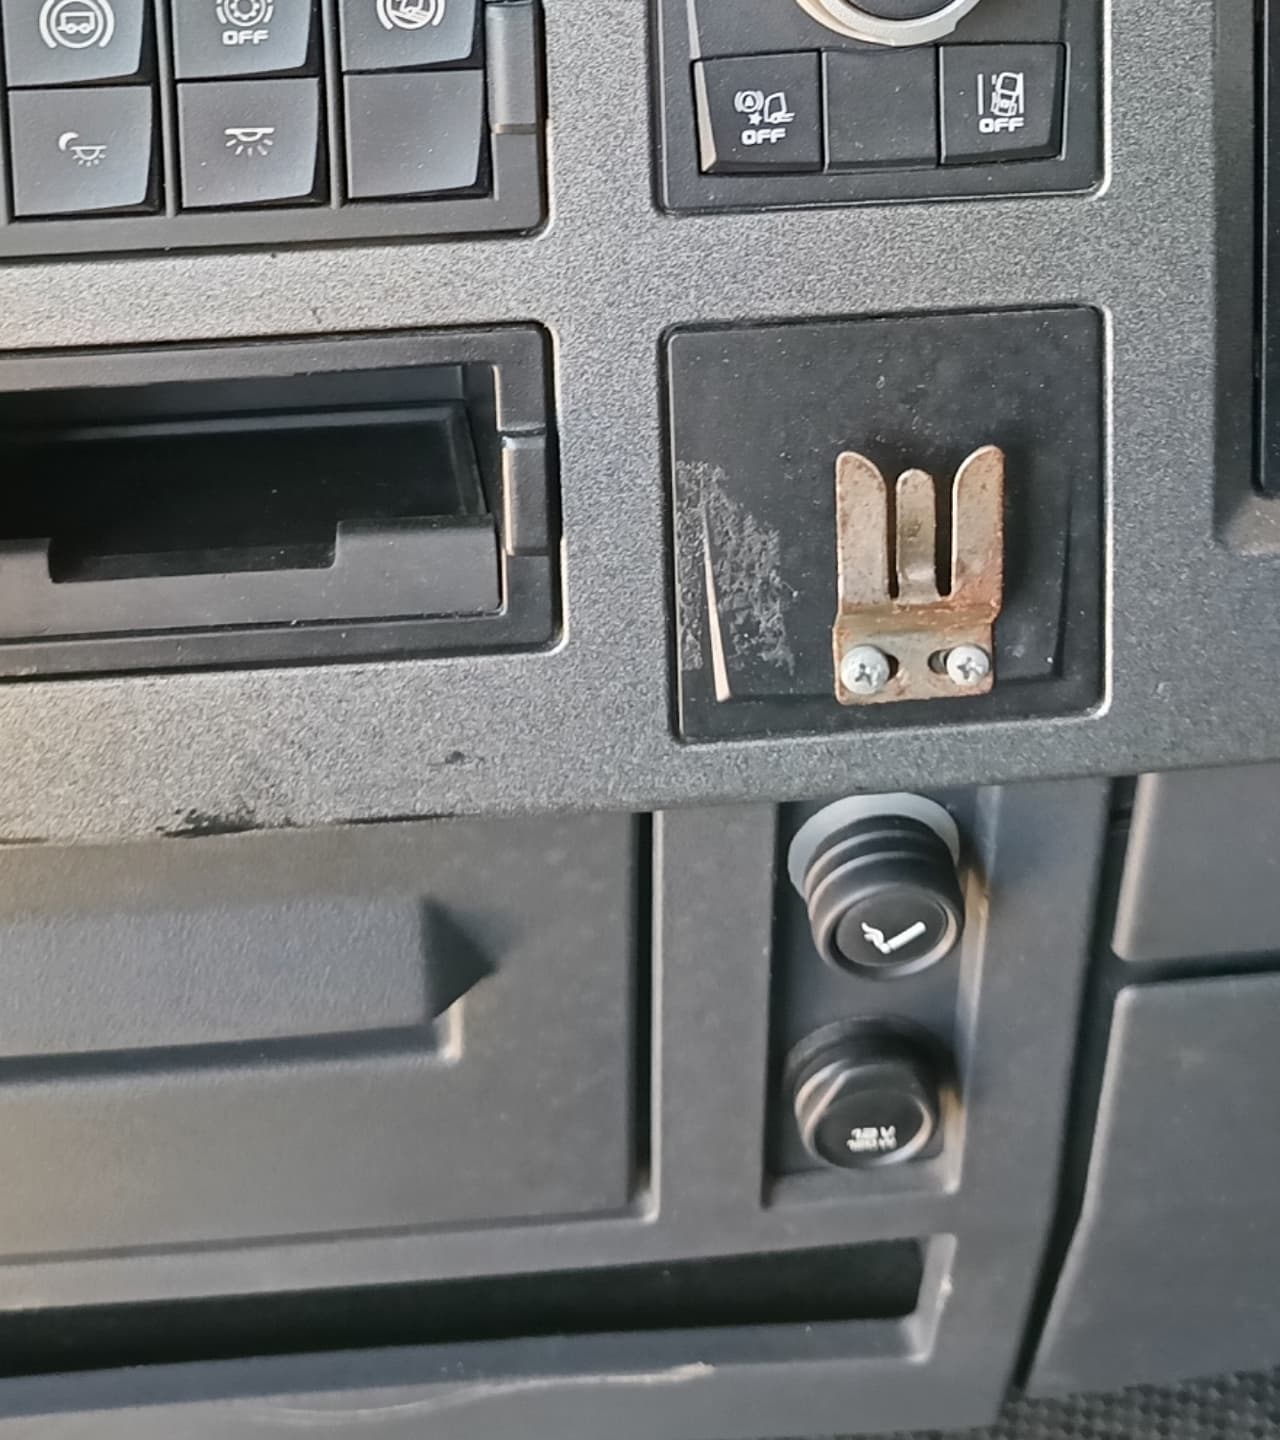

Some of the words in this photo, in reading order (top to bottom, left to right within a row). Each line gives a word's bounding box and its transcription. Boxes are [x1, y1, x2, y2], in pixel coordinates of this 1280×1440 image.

[223, 30, 270, 46] OFF
[979, 117, 1024, 134] OFF
[741, 127, 786, 146] OFF
